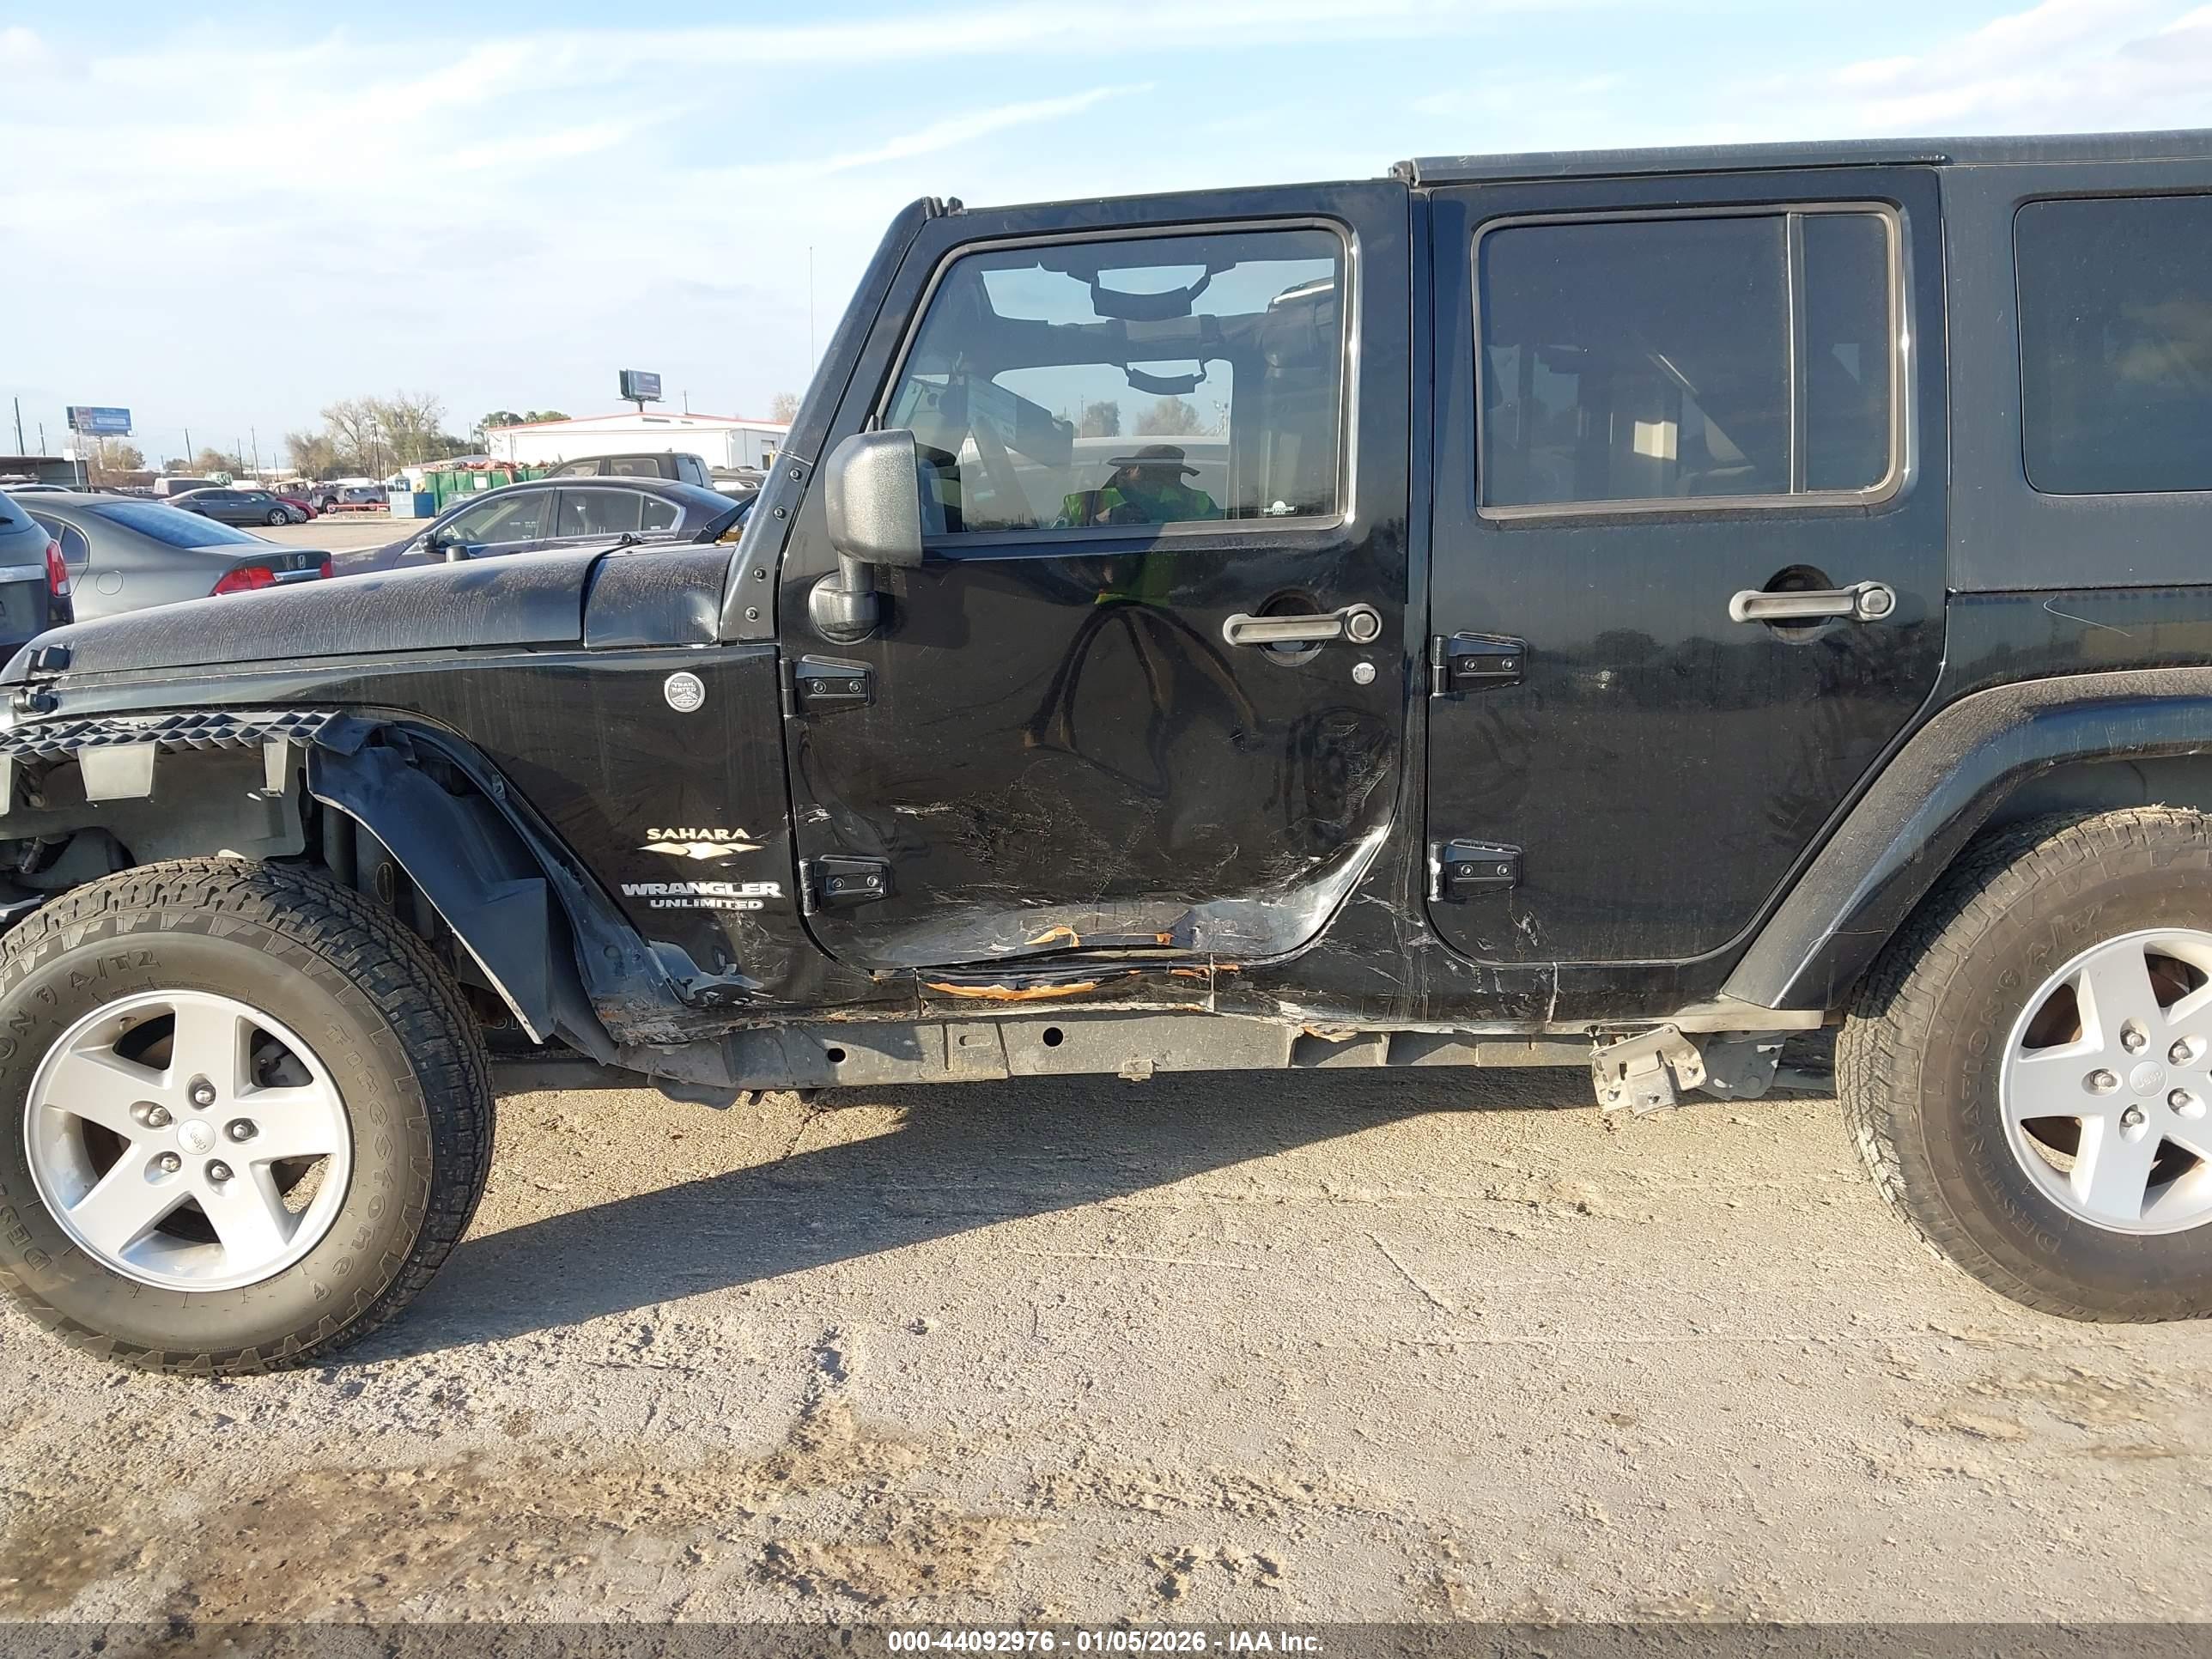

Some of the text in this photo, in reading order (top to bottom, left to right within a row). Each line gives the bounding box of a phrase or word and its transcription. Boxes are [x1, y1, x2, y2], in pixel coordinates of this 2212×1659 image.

[647, 828, 750, 842] SAHARA
[621, 882, 783, 898] WRANGLER
[650, 899, 764, 911] UNLIMITED
[2136, 1069, 2163, 1089] Jeep
[1960, 999, 2060, 1255] DESTINATION
